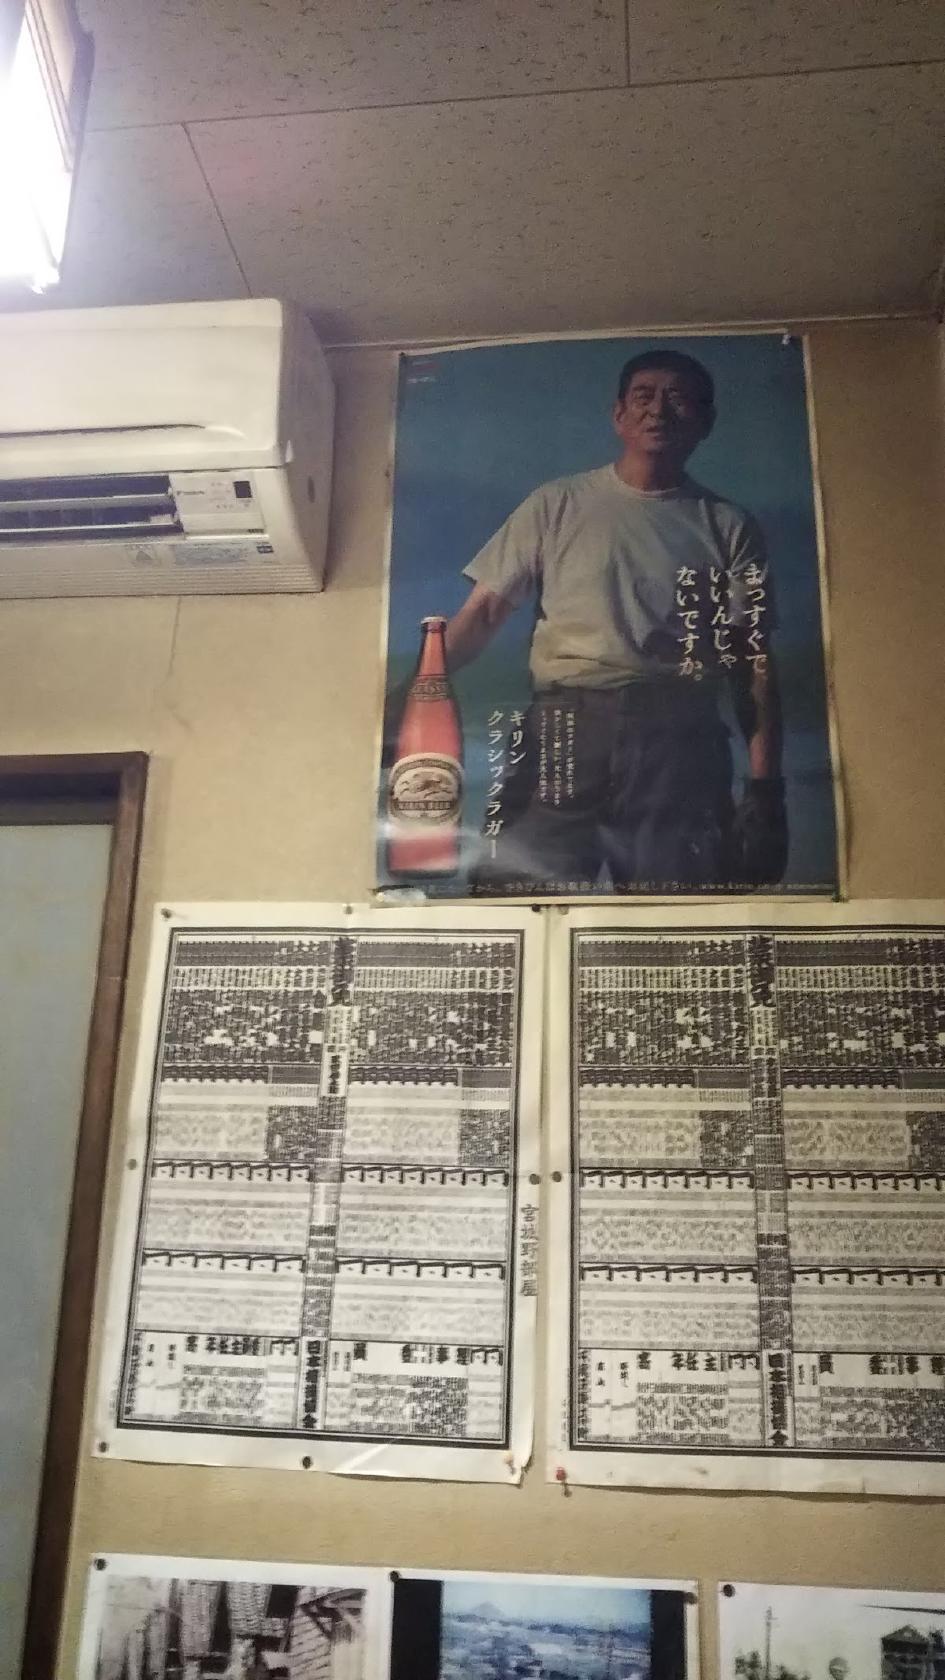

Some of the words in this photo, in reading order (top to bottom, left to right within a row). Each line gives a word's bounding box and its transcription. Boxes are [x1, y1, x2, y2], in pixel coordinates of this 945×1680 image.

[676, 566, 703, 681] ないですか。
[710, 566, 740, 669] いいんじゃ
[743, 563, 767, 673] まっすぐで
[485, 710, 504, 859] クラシックラガー
[510, 710, 527, 765] キリン
